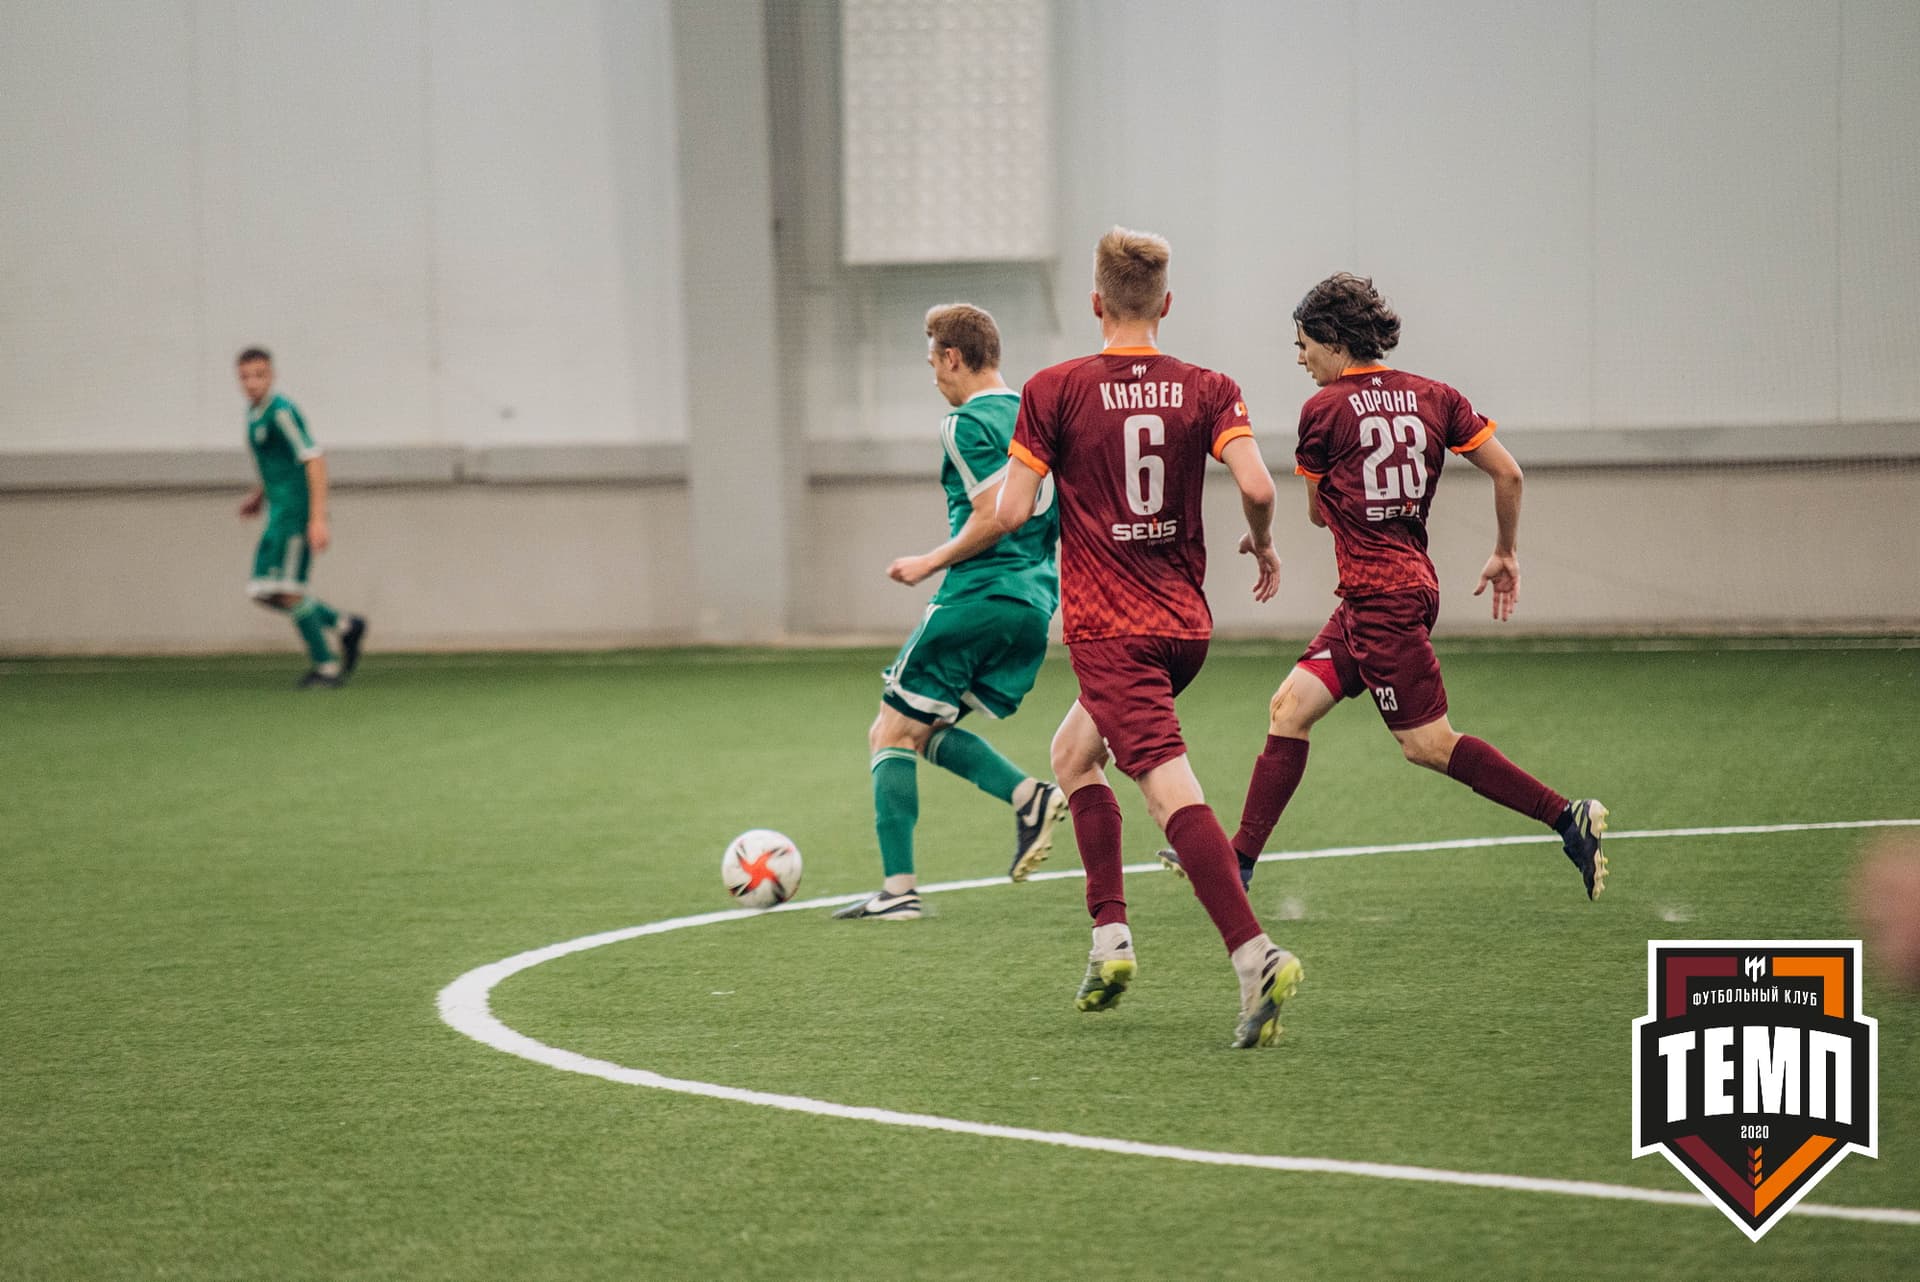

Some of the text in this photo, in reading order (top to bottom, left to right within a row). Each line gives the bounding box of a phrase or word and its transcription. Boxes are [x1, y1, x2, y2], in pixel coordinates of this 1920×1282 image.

[1099, 381, 1184, 411] КНЯЗЕВ
[1348, 389, 1419, 417] ВОРОНА
[1123, 413, 1166, 516] 6
[1359, 414, 1429, 501] 23
[1111, 519, 1177, 541] SEUS
[1375, 686, 1399, 712] 23
